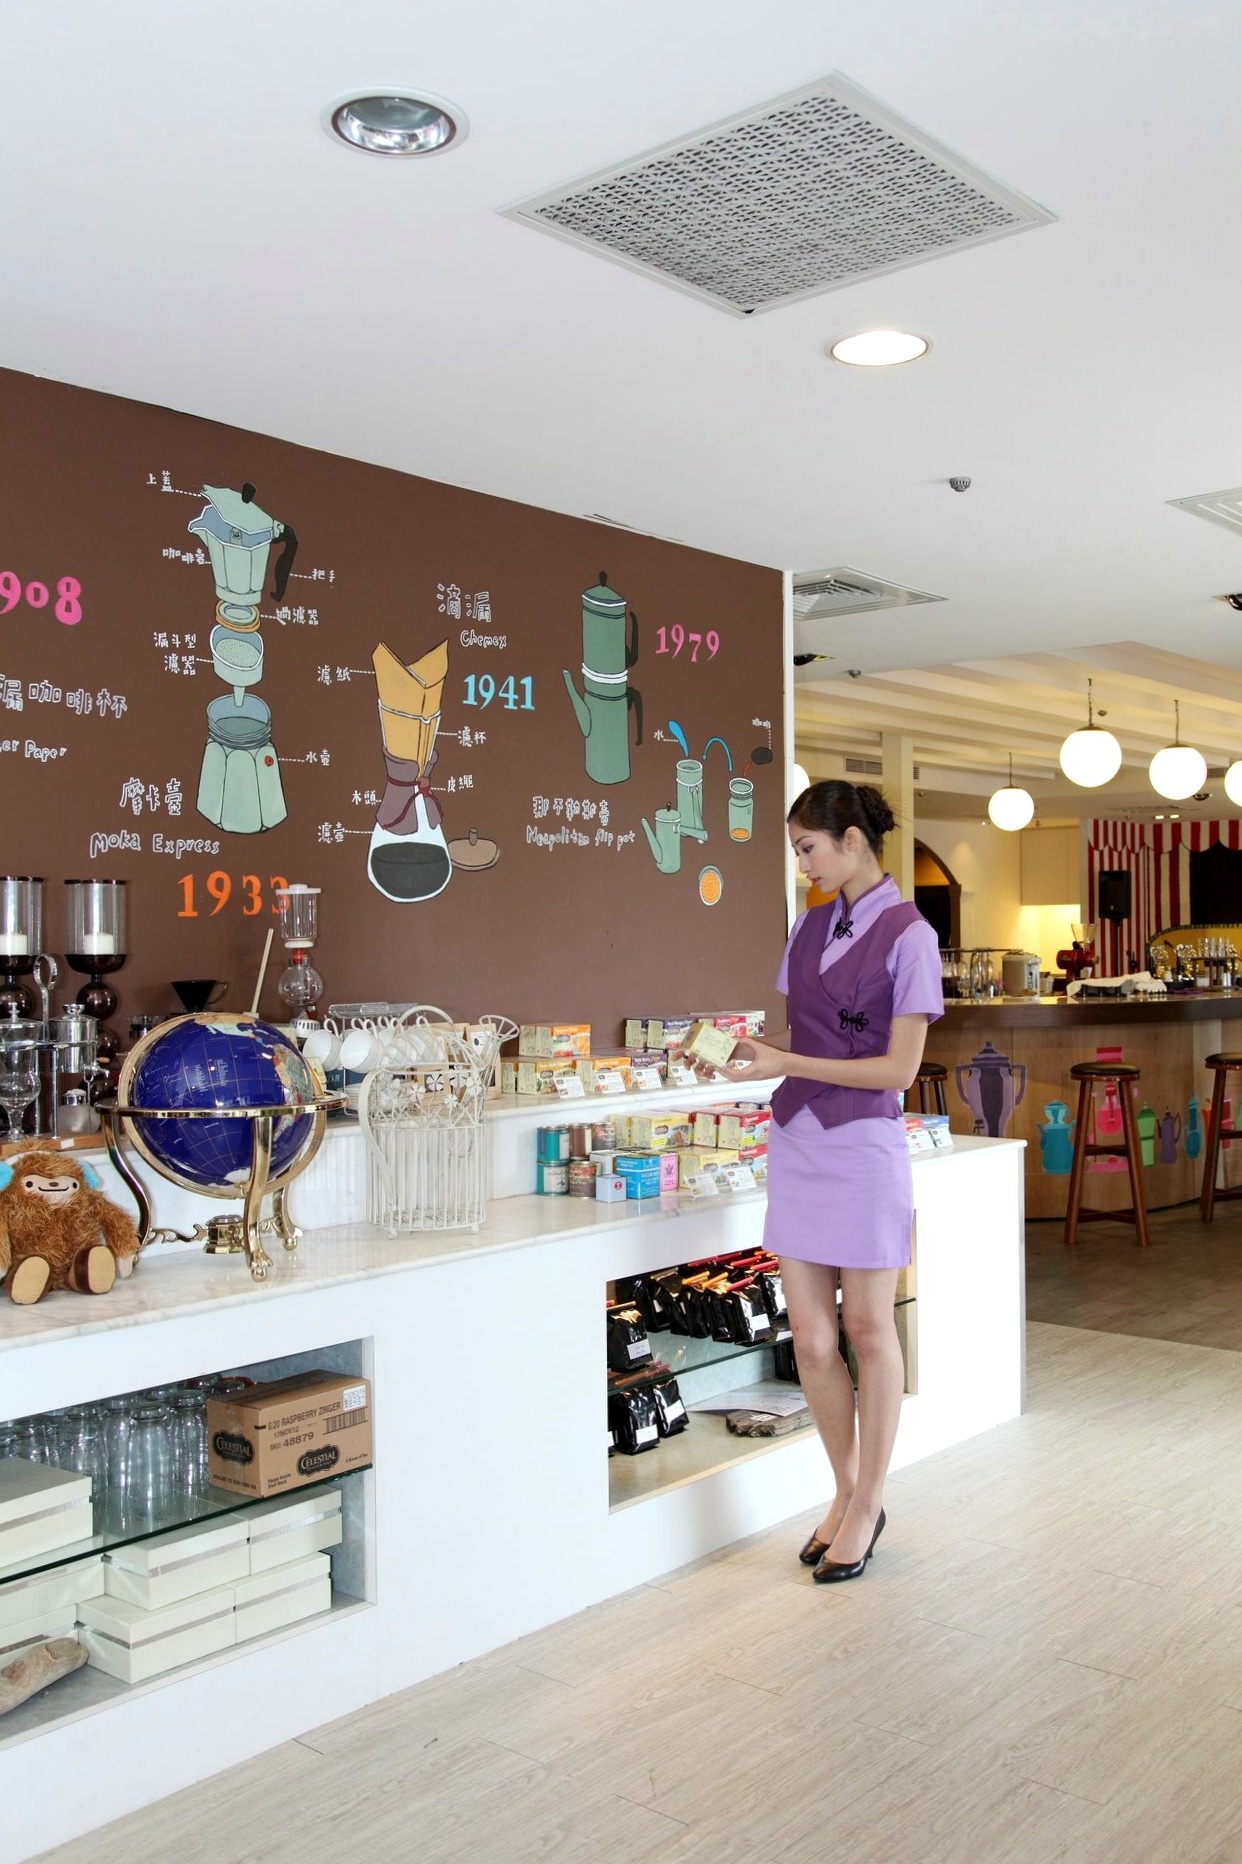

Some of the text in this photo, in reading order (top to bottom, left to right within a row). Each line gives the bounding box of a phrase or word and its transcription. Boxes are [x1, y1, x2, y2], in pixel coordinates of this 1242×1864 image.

[311, 568, 336, 583] 把手
[436, 583, 491, 622] 滴漏
[153, 632, 197, 648] 漏斗型
[460, 629, 507, 649] Chemex
[655, 624, 720, 662] 1979
[462, 673, 535, 711] 1941
[653, 729, 665, 741] 水
[25, 740, 68, 762] Paper
[90, 830, 220, 859] Moka Express
[177, 870, 290, 917] 1933
[281, 1408, 317, 1425] RASPBERRY
[318, 1401, 341, 1416] ZINGER
[216, 1436, 252, 1457] CELESTIAL
[283, 1431, 314, 1447] 48879
[301, 1450, 338, 1469] CELESTIAL
